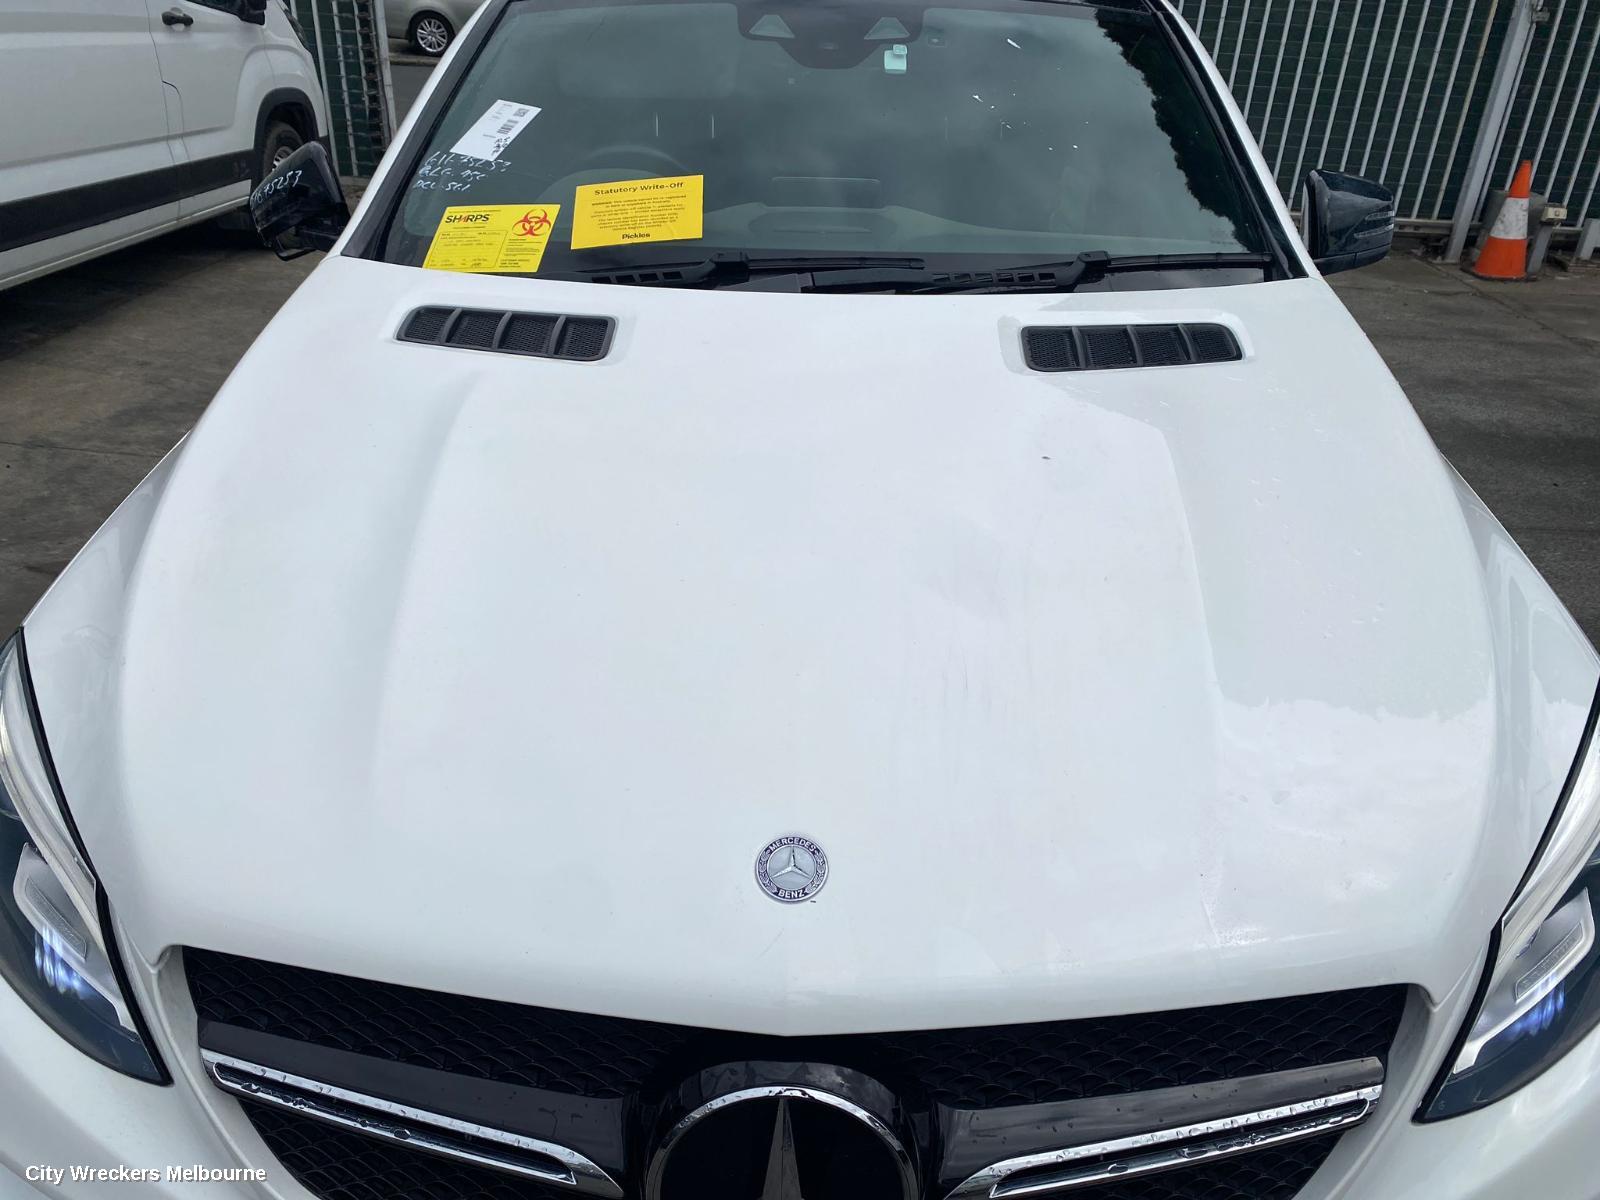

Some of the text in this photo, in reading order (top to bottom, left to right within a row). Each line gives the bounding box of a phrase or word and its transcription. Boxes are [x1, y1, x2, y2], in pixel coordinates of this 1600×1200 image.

[594, 181, 685, 196] Statutory Write-Off
[445, 213, 490, 223] SHARPS
[621, 232, 651, 240] Pickles
[768, 837, 816, 852] MERCEDES
[778, 889, 805, 899] BENZ
